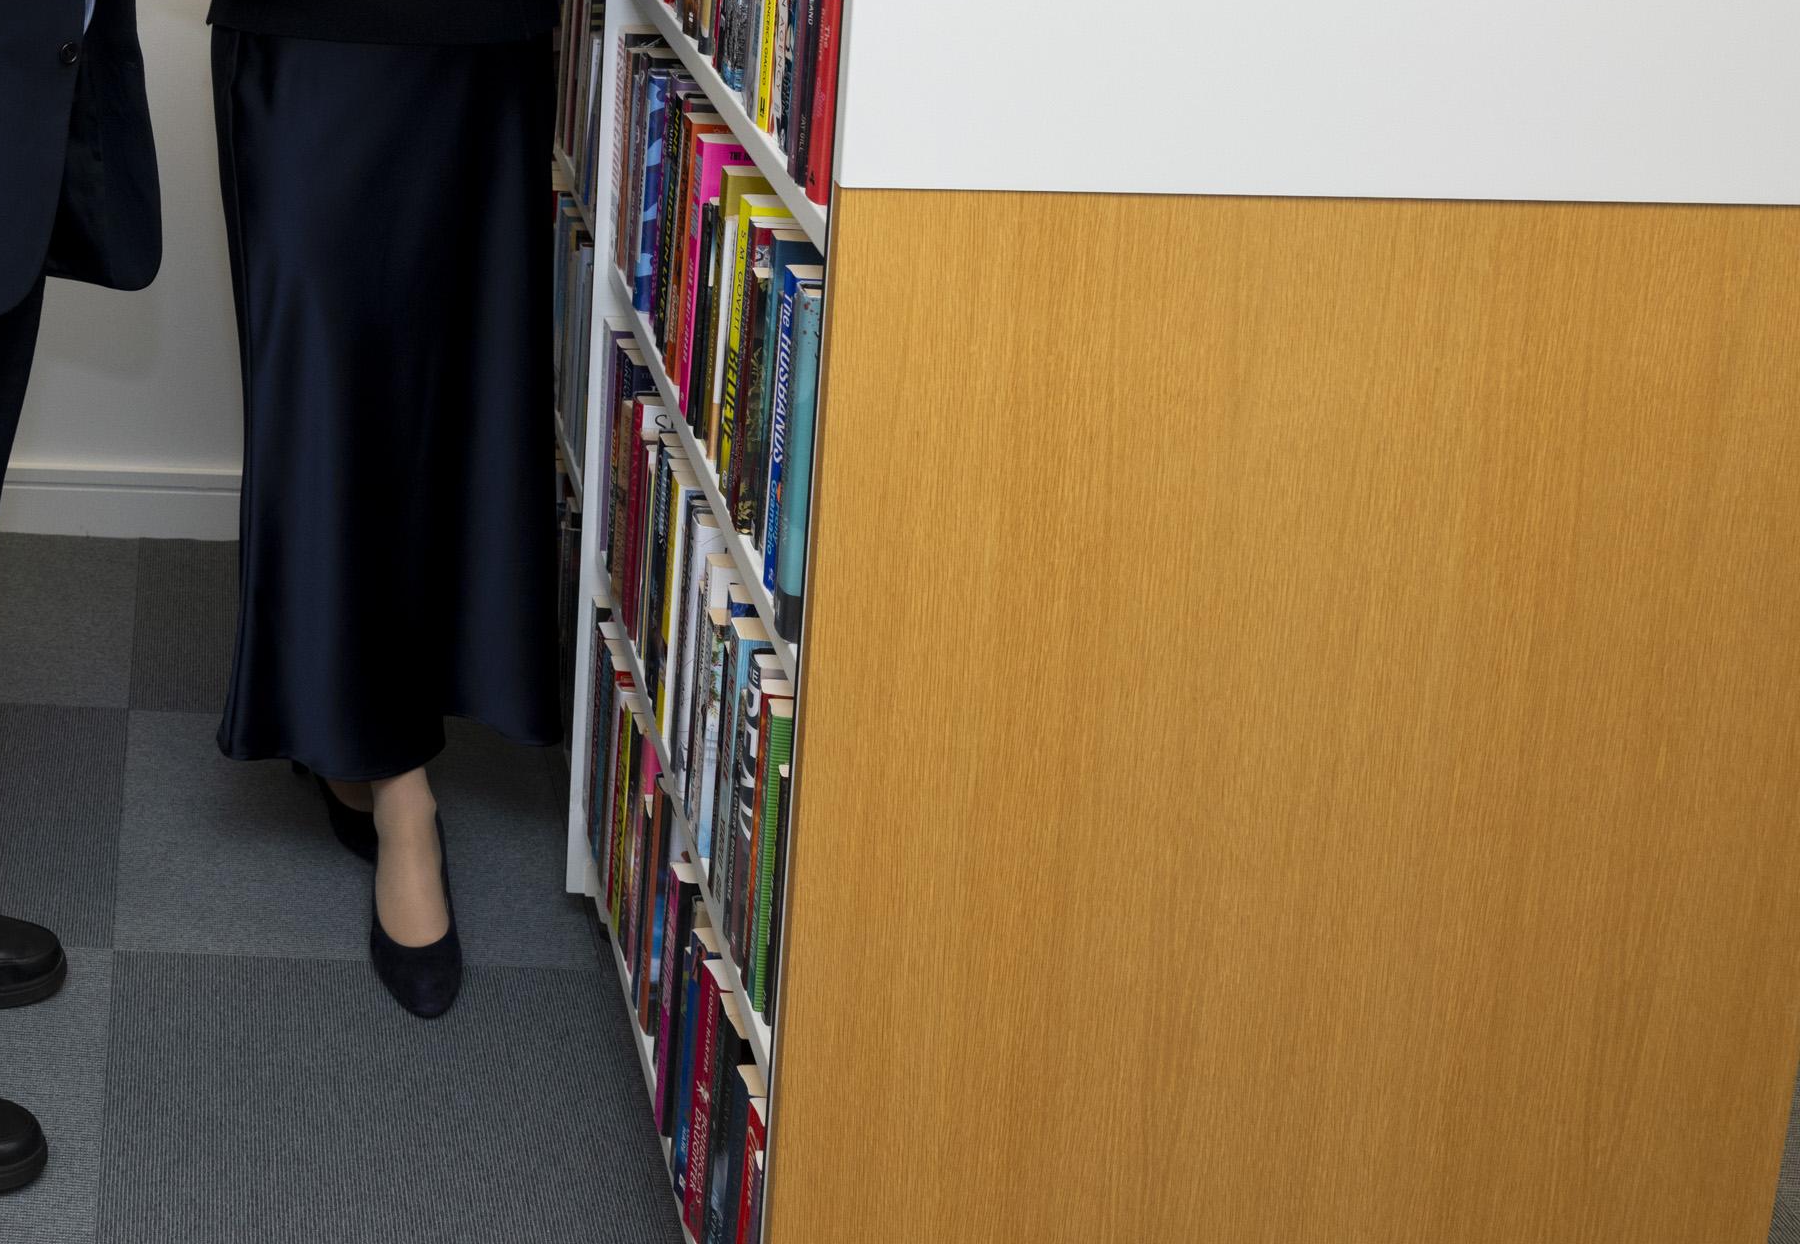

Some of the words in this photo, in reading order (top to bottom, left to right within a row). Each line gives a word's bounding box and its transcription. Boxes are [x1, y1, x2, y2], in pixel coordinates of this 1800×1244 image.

[775, 14, 785, 90] AGENCY
[693, 153, 703, 200] WHITE
[664, 183, 674, 261] HIDDEN
[690, 202, 699, 239] KING
[741, 230, 746, 240] S.
[739, 245, 744, 261] M.
[659, 266, 668, 321] LIVES
[669, 284, 677, 342] Goddard
[734, 271, 743, 331] GOVETT
[783, 293, 792, 326] The
[723, 347, 738, 442] BELIEVE
[773, 331, 791, 467] HUSBANDS
[767, 477, 777, 552] Gramazio
[729, 675, 734, 700] ME
[723, 703, 732, 784] ISHMAELLE
[739, 678, 759, 841] DEAD
[735, 780, 738, 788] A
[615, 805, 625, 902] CONTEST
[718, 812, 726, 867] XIAOLU
[727, 836, 735, 900] DISCOURSE
[706, 984, 714, 1025] ELODIE
[703, 1029, 712, 1074] HARPER
[690, 1108, 701, 1191] DAUGHTER
[696, 1113, 707, 1204] BOUDICCA'S
